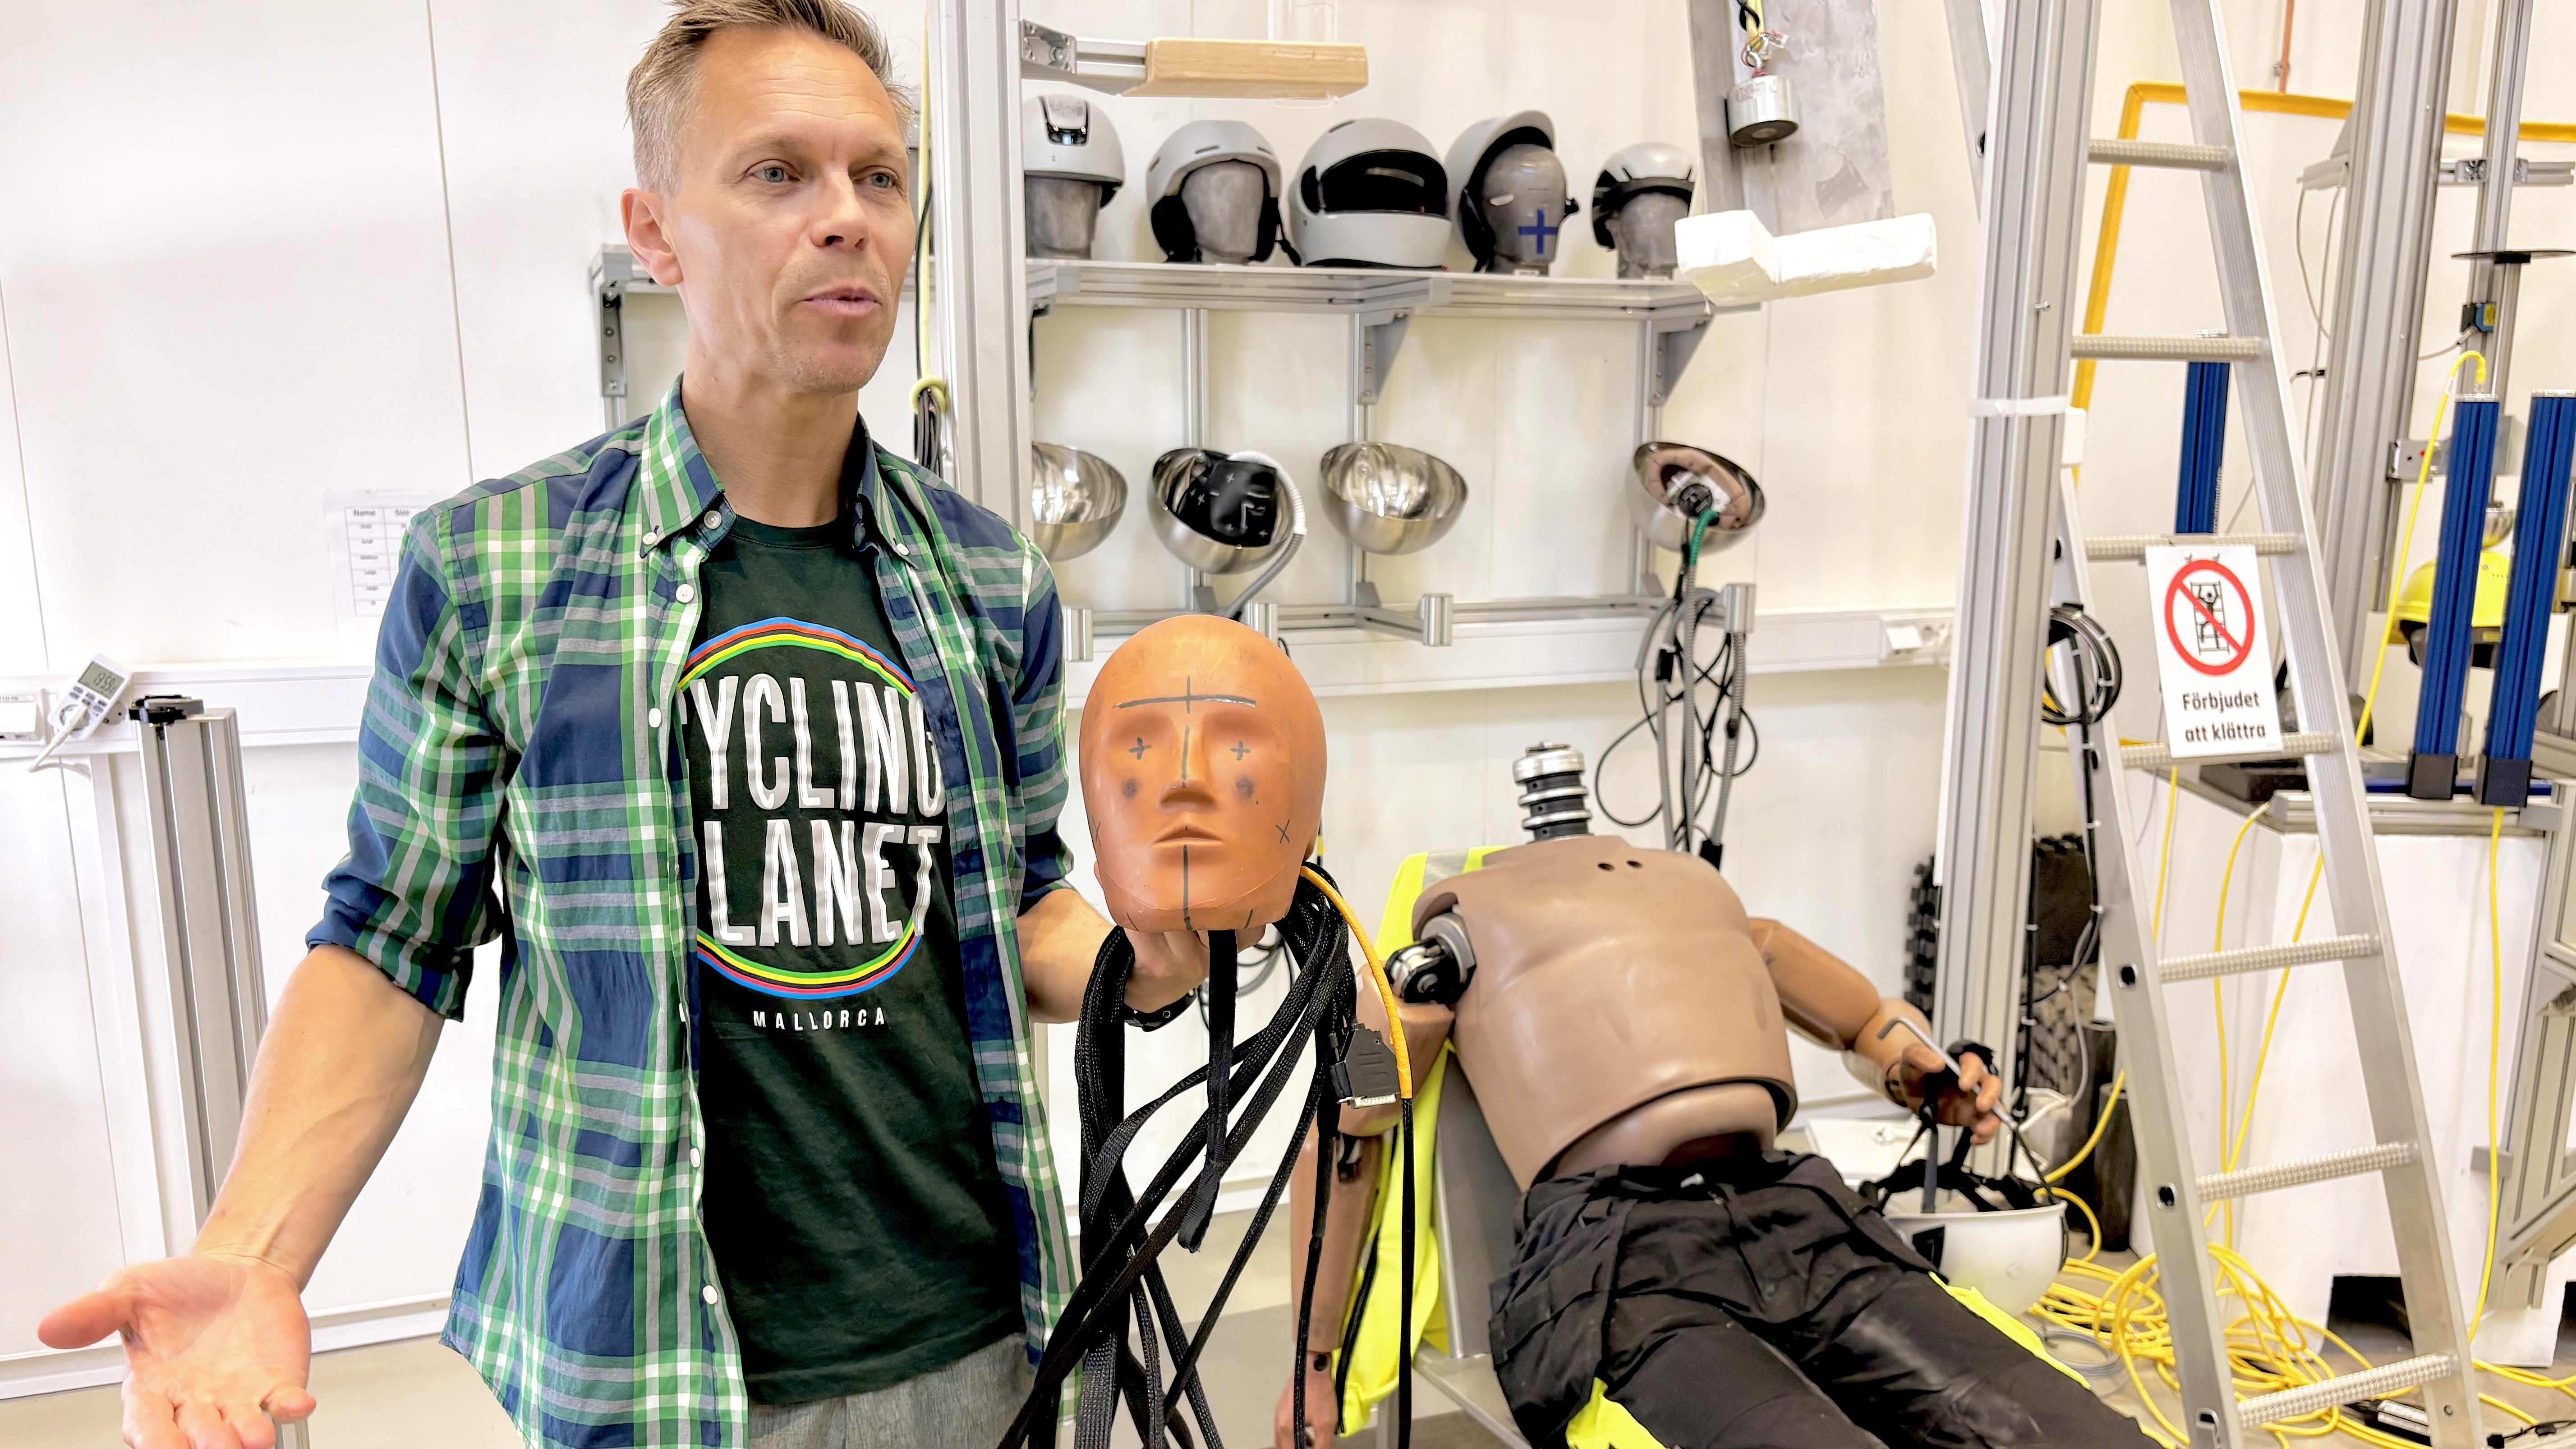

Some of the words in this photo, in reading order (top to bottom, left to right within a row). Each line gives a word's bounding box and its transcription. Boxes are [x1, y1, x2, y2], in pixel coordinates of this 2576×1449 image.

[2182, 690, 2259, 713] Förbjudet
[2186, 725, 2208, 742] att
[2213, 722, 2266, 741] klättra
[754, 1007, 884, 1031] MALLORCA
